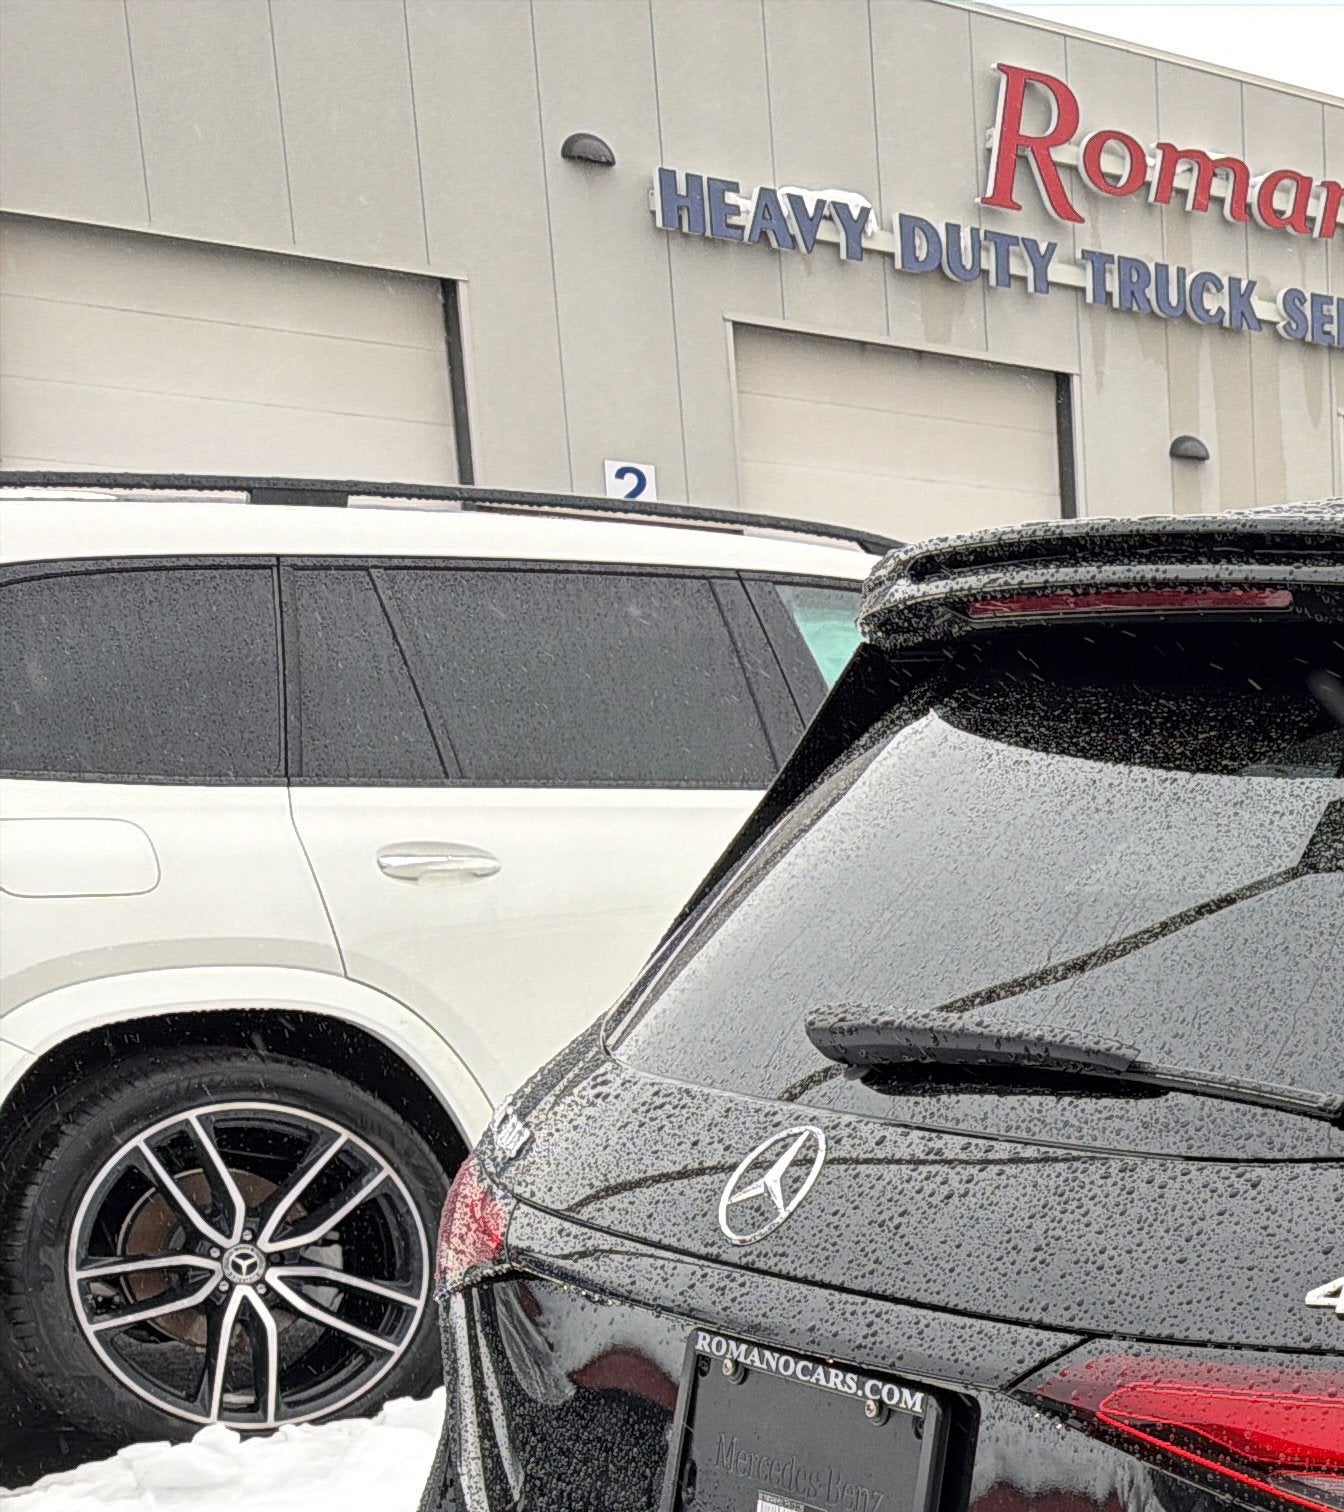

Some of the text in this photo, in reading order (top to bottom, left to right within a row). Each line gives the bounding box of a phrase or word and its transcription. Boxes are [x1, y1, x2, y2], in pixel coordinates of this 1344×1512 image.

[657, 167, 871, 262] HEAVY
[896, 213, 1059, 295] DUTY
[1081, 249, 1262, 332] TRUCK
[614, 466, 646, 499] 2
[695, 1331, 925, 1414] ROMANOCARS.COM
